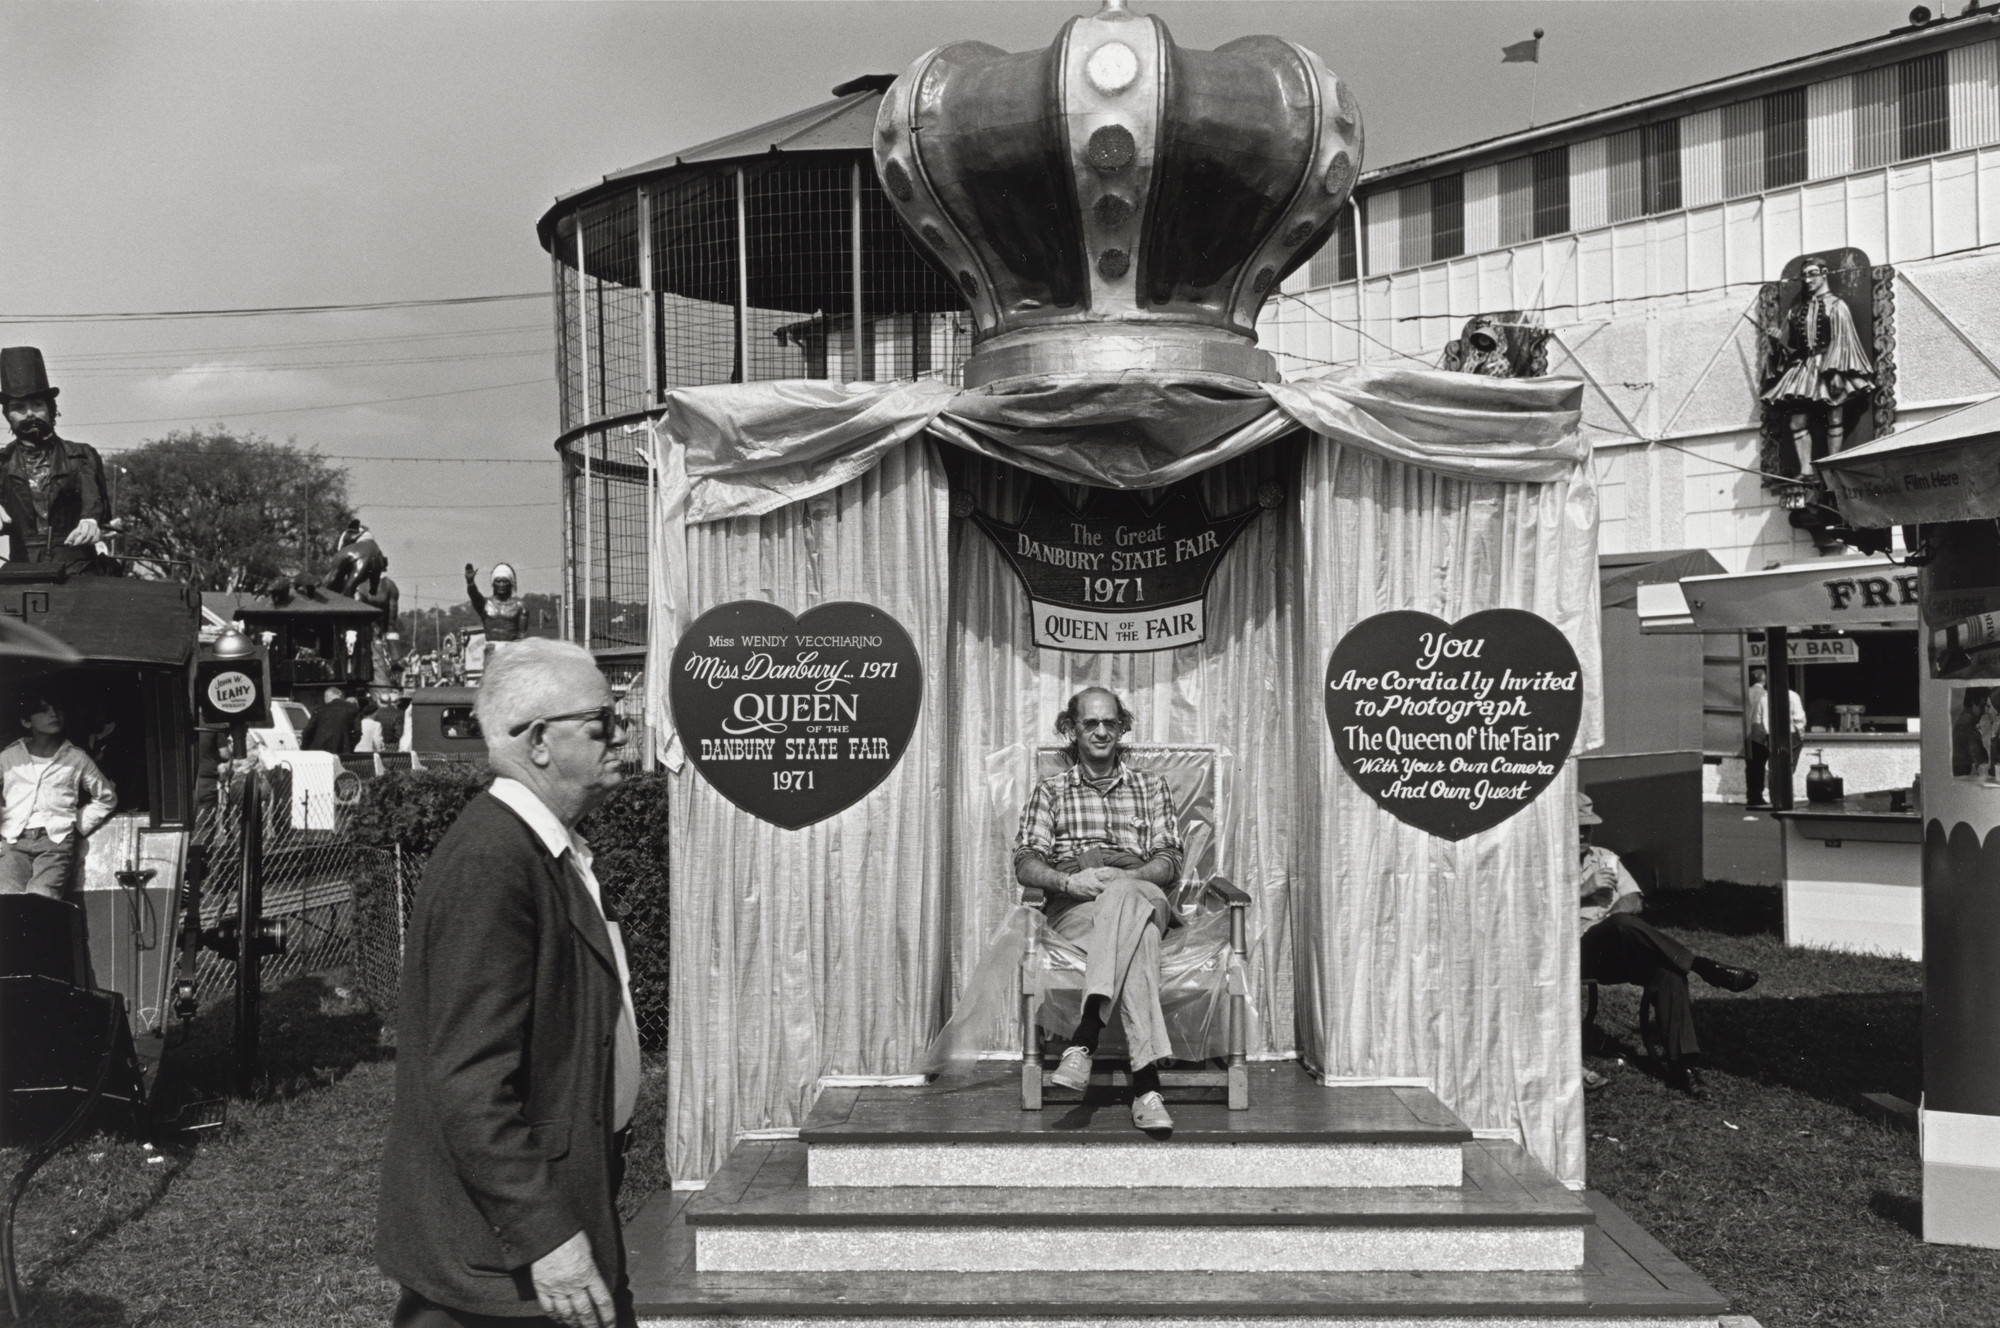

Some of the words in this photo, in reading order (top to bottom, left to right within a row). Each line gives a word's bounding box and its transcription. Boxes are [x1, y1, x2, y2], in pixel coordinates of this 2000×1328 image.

[1903, 474, 1930, 492] Film
[1930, 470, 1960, 488] Here
[1070, 522, 1102, 547] The
[1115, 522, 1167, 547] Great
[1017, 531, 1105, 571] DANBURY
[1111, 547, 1167, 572] STATE
[1174, 530, 1221, 563] FAIR
[1082, 576, 1145, 603] 1971
[1044, 614, 1109, 643] QUEEN
[1115, 630, 1139, 642] THE
[1119, 621, 1135, 630] OF
[1145, 612, 1197, 640] FAIR
[708, 635, 735, 647] Miss
[741, 635, 788, 647] WENDY
[795, 635, 883, 649] VECCHIARINO
[1416, 632, 1486, 671] You
[1806, 641, 1844, 655] BAR
[684, 651, 739, 690] Miss
[859, 661, 898, 679] 1971
[214, 678, 232, 690] JOHN
[216, 685, 251, 701] LEAHY
[1330, 669, 1379, 691] Are
[1381, 670, 1495, 700] Cordially
[1499, 668, 1578, 691] Invited
[721, 692, 860, 735] QUEEN
[1354, 699, 1377, 717] to
[1376, 694, 1532, 725] Photograph
[806, 725, 823, 733] OF
[825, 725, 850, 733] THE
[1343, 725, 1383, 751] The
[1385, 725, 1453, 755] Queen
[1455, 725, 1478, 751] of
[1480, 726, 1510, 751] the
[1510, 725, 1560, 752] Fair
[700, 738, 776, 761] DANBURY
[785, 738, 838, 760] STATE
[848, 737, 890, 760] FAIR
[772, 770, 815, 791] 1971
[1353, 757, 1399, 775] With
[1400, 757, 1446, 782] Your
[1449, 756, 1489, 774] Own
[1490, 756, 1555, 775] Camera
[1381, 780, 1429, 799] And
[1429, 780, 1471, 800] Own
[1468, 779, 1532, 811] Guest
